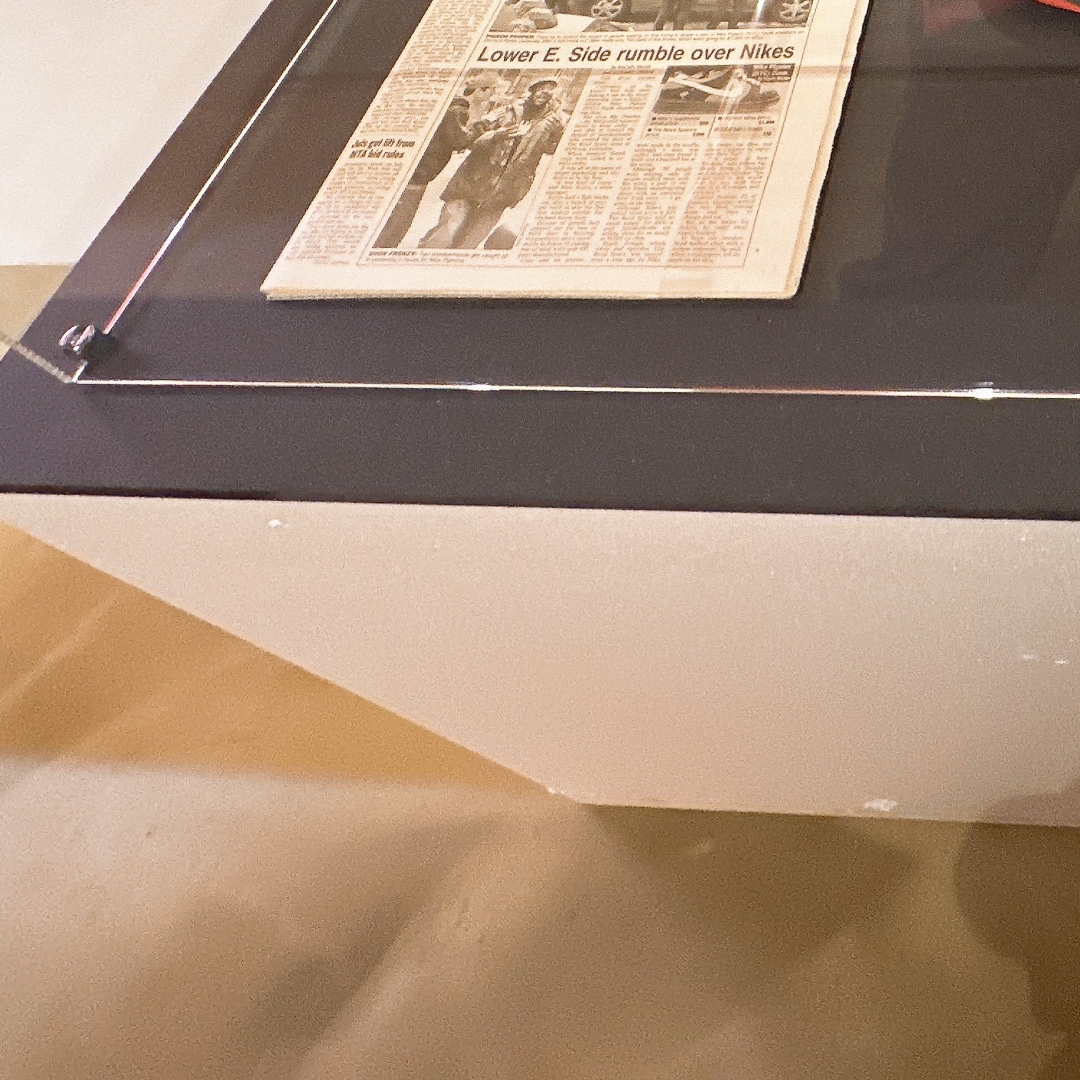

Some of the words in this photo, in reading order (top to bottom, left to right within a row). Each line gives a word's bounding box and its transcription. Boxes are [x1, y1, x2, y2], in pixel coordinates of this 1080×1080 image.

[476, 47, 539, 62] Lower
[543, 47, 561, 62] E.
[568, 46, 611, 62] Side
[616, 45, 684, 62] rumble
[690, 47, 735, 60] over
[740, 43, 795, 60] Nikes
